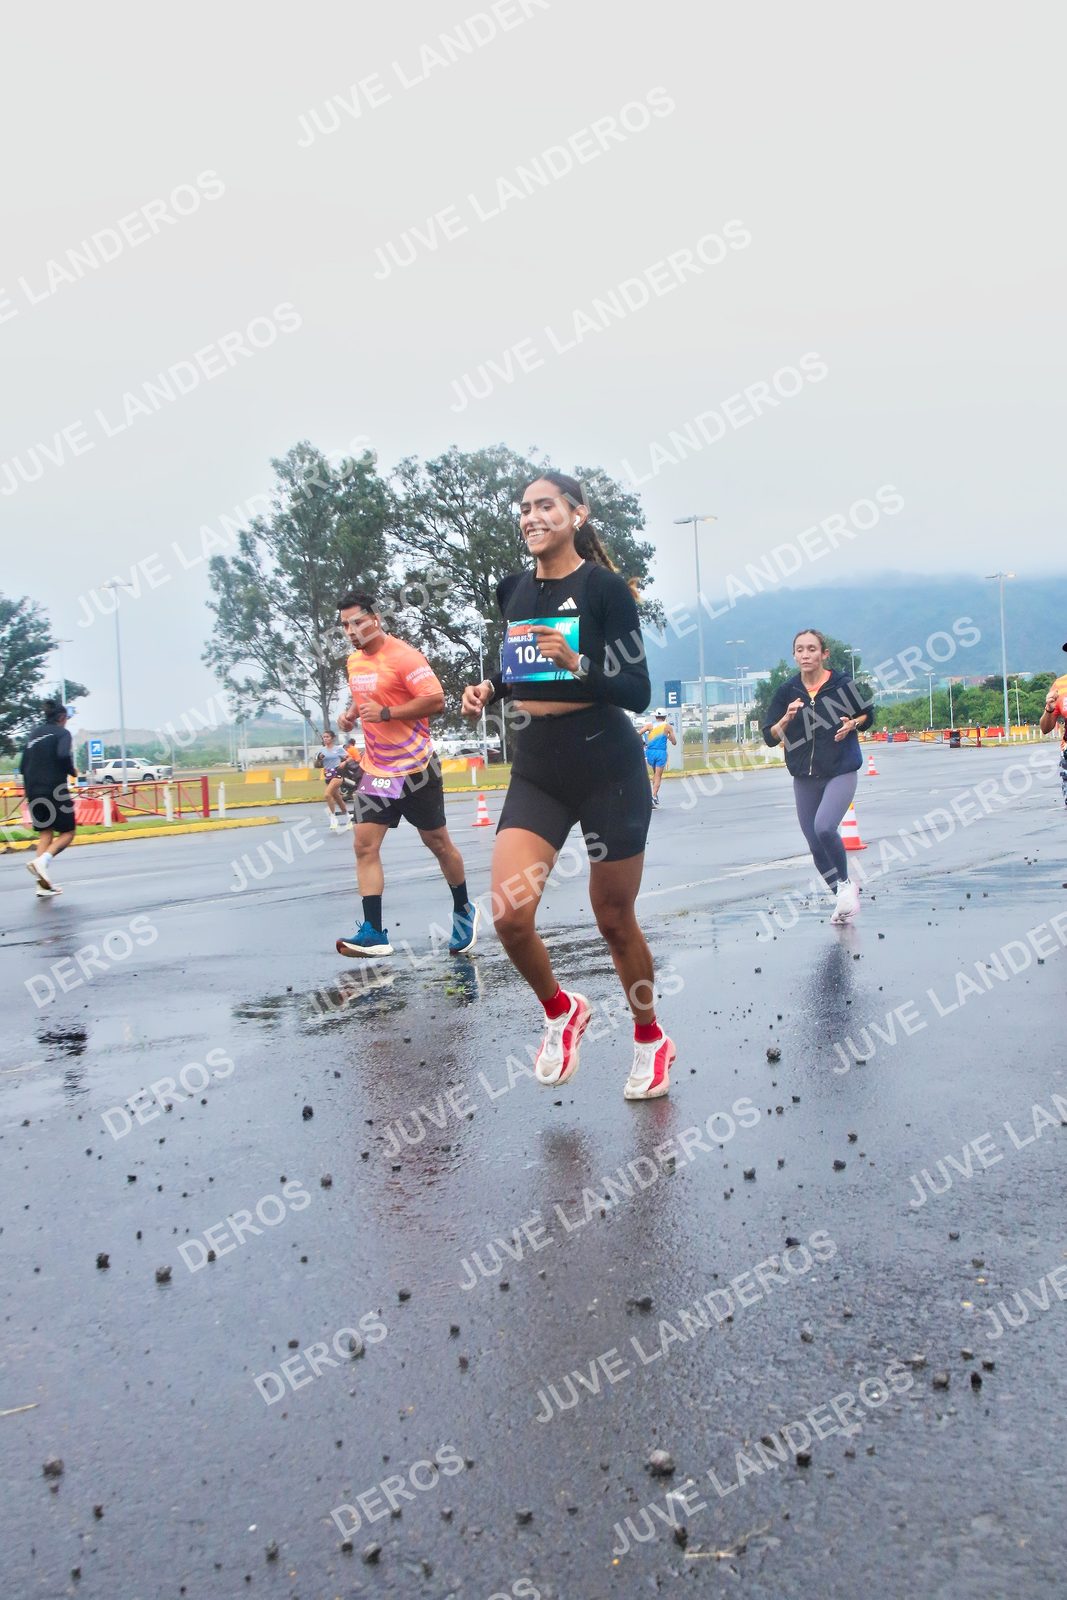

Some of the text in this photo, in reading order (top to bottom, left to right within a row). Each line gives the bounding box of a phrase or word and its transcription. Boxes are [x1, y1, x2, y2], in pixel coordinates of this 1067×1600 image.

[515, 646, 554, 664] 102
[668, 691, 677, 704] E
[371, 778, 391, 789] 499
